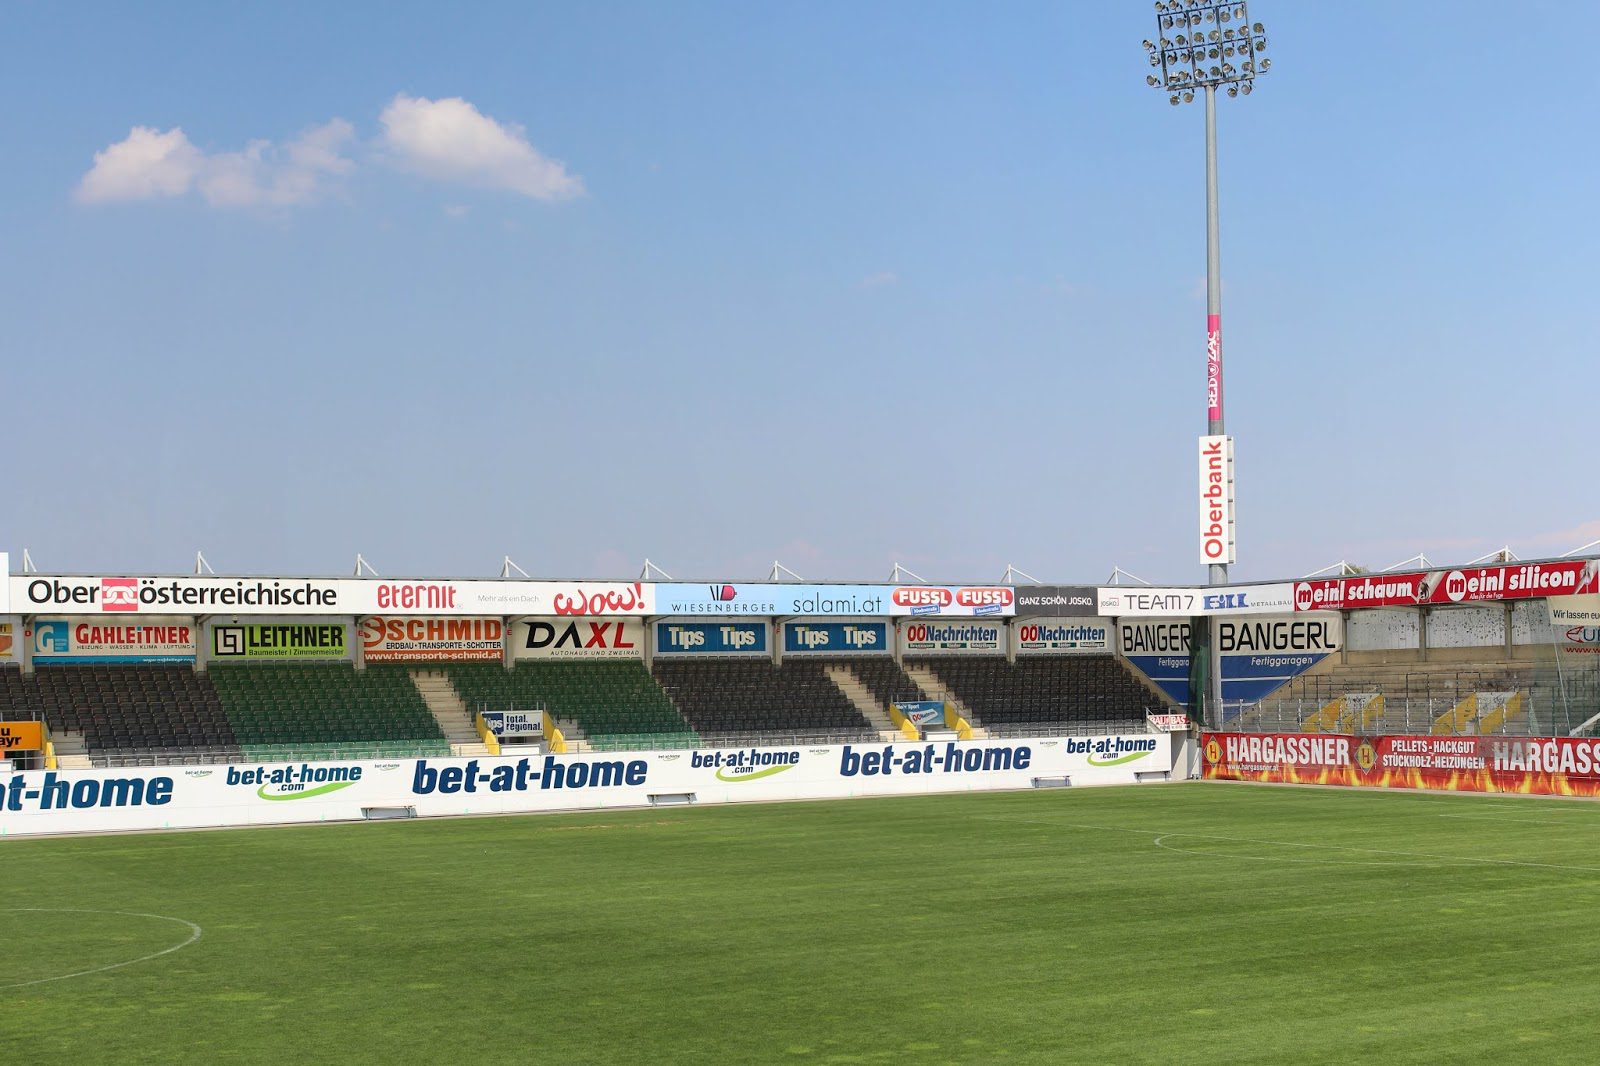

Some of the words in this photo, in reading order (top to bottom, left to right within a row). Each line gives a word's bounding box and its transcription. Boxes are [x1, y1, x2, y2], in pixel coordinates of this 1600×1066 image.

[1207, 331, 1217, 362] ZAC
[1208, 378, 1218, 408] RED
[1203, 442, 1222, 558] Oberbank
[1448, 568, 1506, 594] meinl
[1509, 566, 1576, 590] silicon
[28, 579, 100, 603] Ober
[139, 580, 337, 605] österreichische
[377, 584, 457, 608] eternit
[554, 581, 645, 614] wow!
[793, 592, 882, 613] salami.at
[900, 591, 948, 604] FUSSL
[962, 591, 1009, 604] FUSSL
[1019, 597, 1039, 605] GANZ
[1041, 595, 1067, 605] SCHÖN
[1068, 597, 1093, 605] JOSKO.
[1298, 580, 1345, 605] meinl
[1348, 579, 1412, 600] schaum
[672, 603, 775, 612] WIESENBERGER
[1553, 609, 1565, 618] Wir
[1566, 610, 1589, 619] lassen
[249, 626, 343, 648] LEITHNER
[387, 619, 502, 641] SCHMID
[522, 621, 634, 649] DAXL
[668, 626, 705, 650] Tips
[720, 626, 756, 649] Tips
[795, 626, 829, 648] Tips
[843, 626, 876, 648] Tips
[908, 623, 998, 641] OÖNachrichten
[1020, 624, 1105, 641] OÖNachrichten
[1219, 621, 1336, 651] BANGERL
[293, 648, 344, 656] Zimmermeister
[365, 651, 501, 660] www.transporte-schmid.at
[466, 641, 502, 649] SCHOTTER
[1251, 656, 1313, 667] Fertiggaragen
[506, 715, 528, 723] total.
[506, 723, 543, 732] regional.
[1066, 737, 1156, 754] bet-at-home
[1226, 737, 1350, 766] HARGASSNER
[691, 749, 800, 768] bet-at-home
[840, 743, 1031, 776] bet-at-home
[1227, 762, 1279, 772] www.hargassner.at
[226, 763, 363, 786] bet-at-home
[412, 756, 648, 794] bet-at-home
[732, 765, 754, 774] .com
[0, 772, 174, 811] t-home
[277, 783, 305, 792] .com
